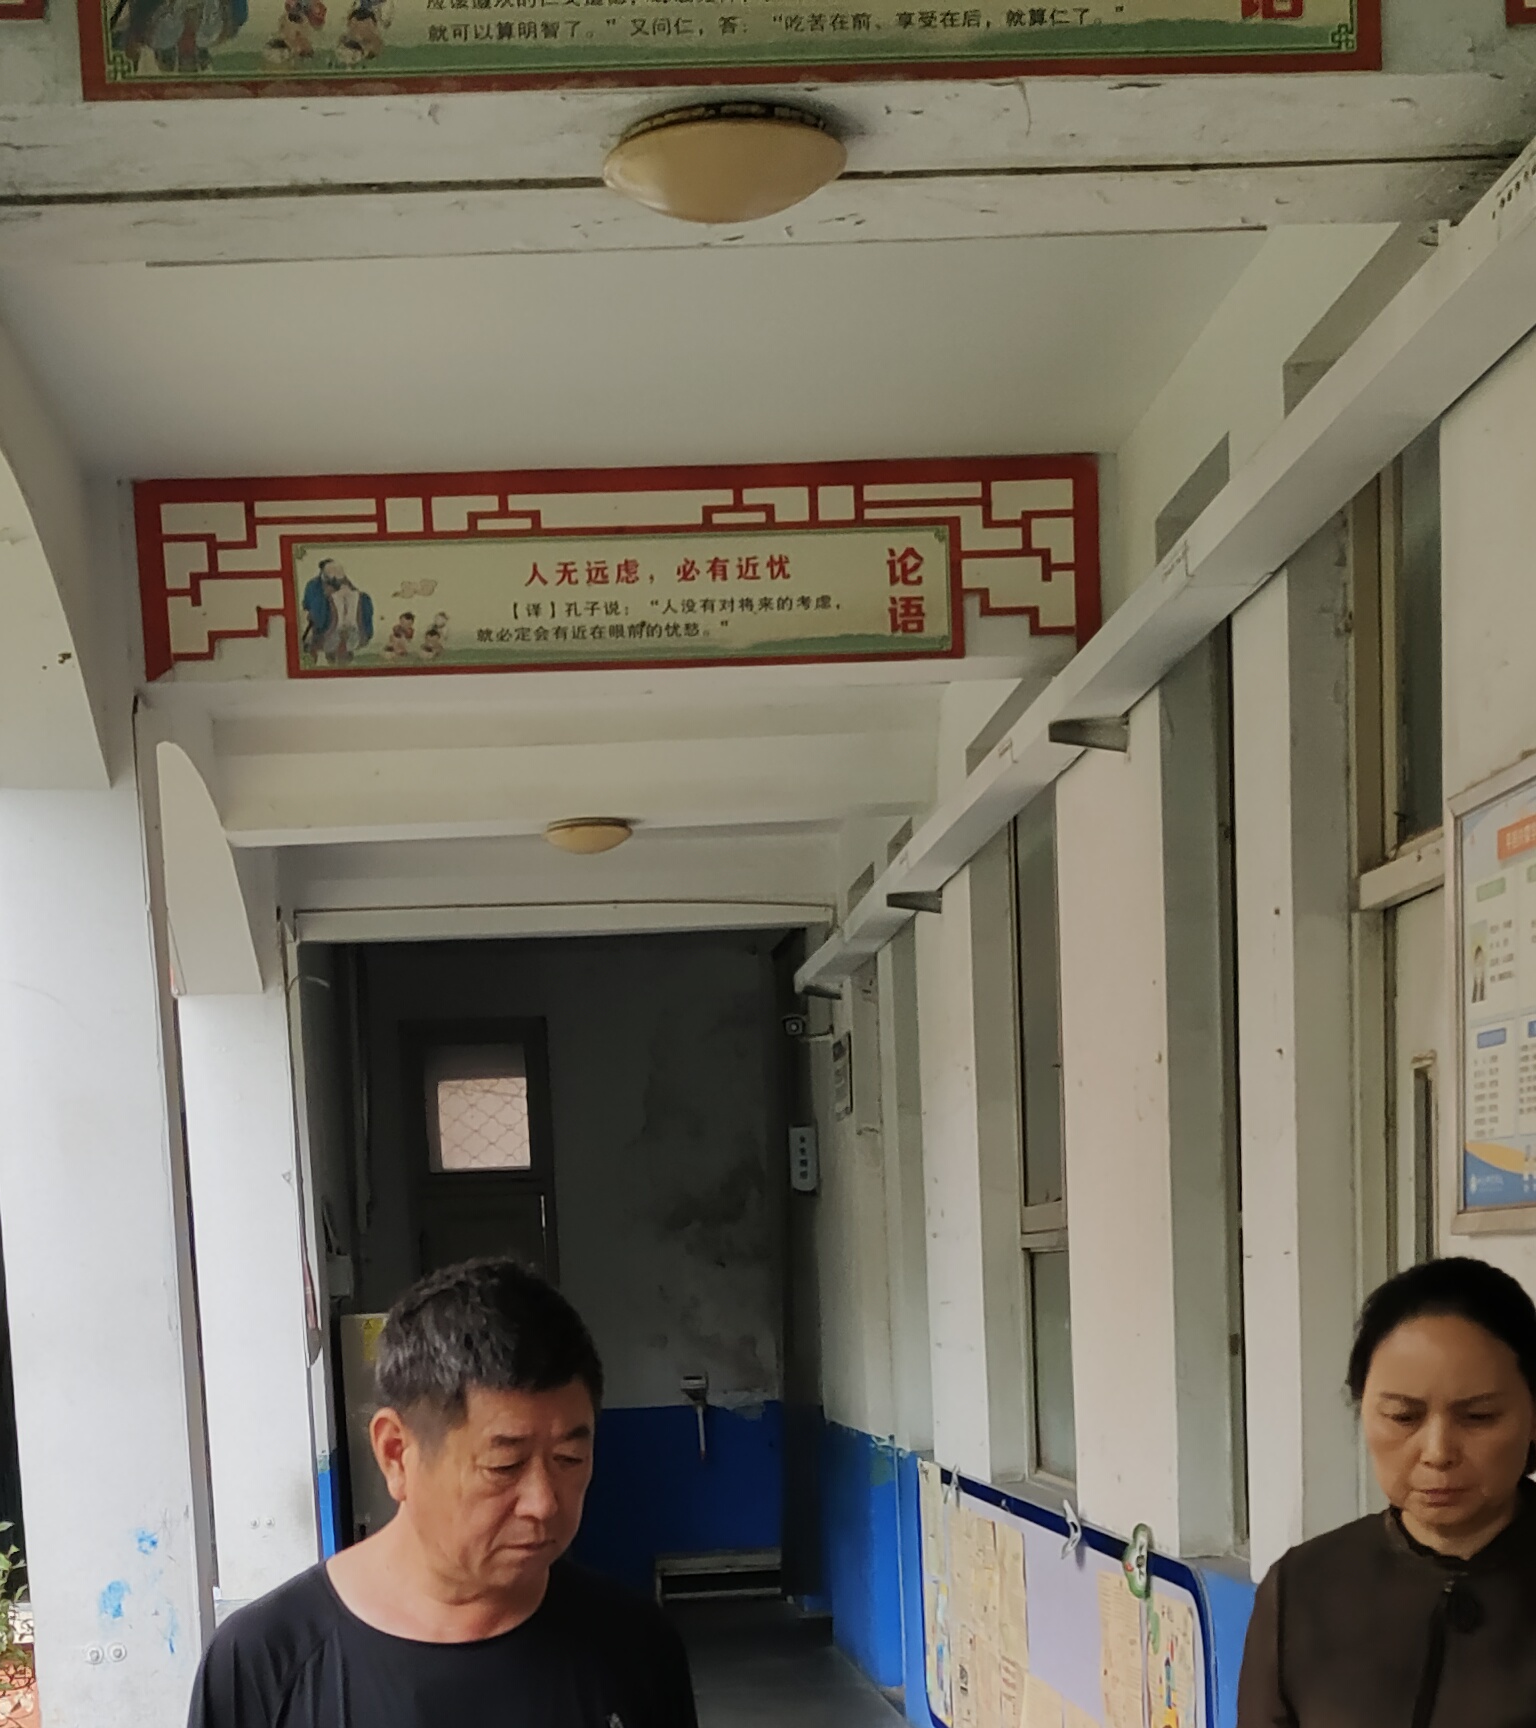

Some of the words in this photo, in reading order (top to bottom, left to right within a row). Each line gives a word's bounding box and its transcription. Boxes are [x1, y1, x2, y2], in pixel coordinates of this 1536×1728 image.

[524, 554, 792, 587] 人无远虑，必有近忧
[886, 546, 925, 633] 论语
